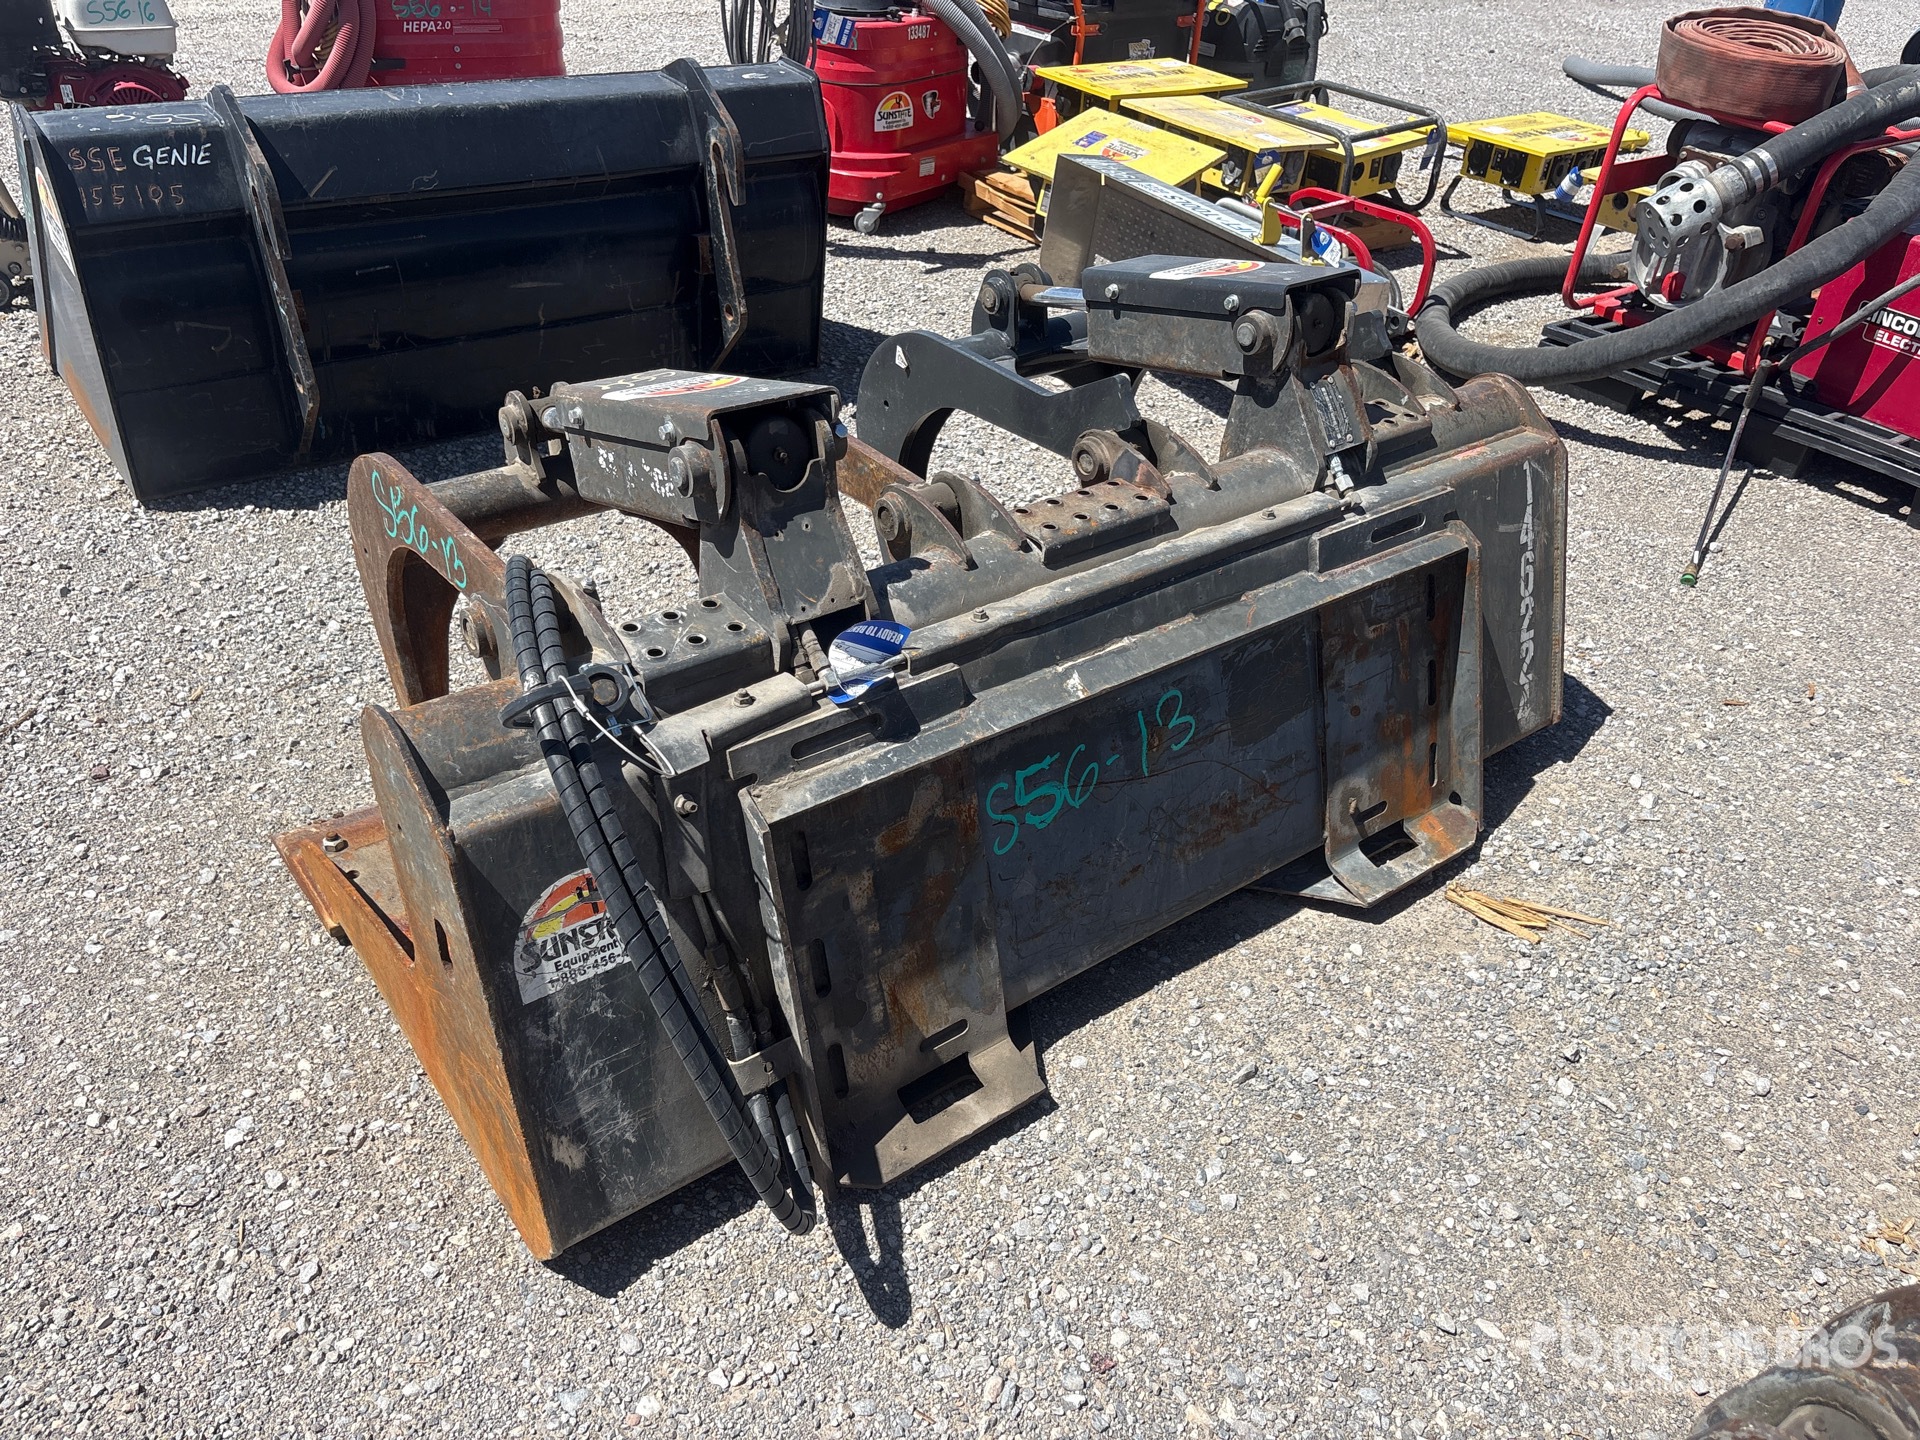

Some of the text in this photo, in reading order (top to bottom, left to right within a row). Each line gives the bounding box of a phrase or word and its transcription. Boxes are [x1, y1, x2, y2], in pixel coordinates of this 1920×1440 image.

[86, 0, 156, 24] S56-16
[907, 24, 931, 40] 133487
[877, 108, 912, 121] SUNSTATE
[68, 143, 212, 172] SSE GENIE
[1866, 309, 1920, 338] INCO
[1874, 329, 1920, 356] ELECT
[371, 469, 467, 589] S56-13
[985, 689, 1196, 855] S56-13
